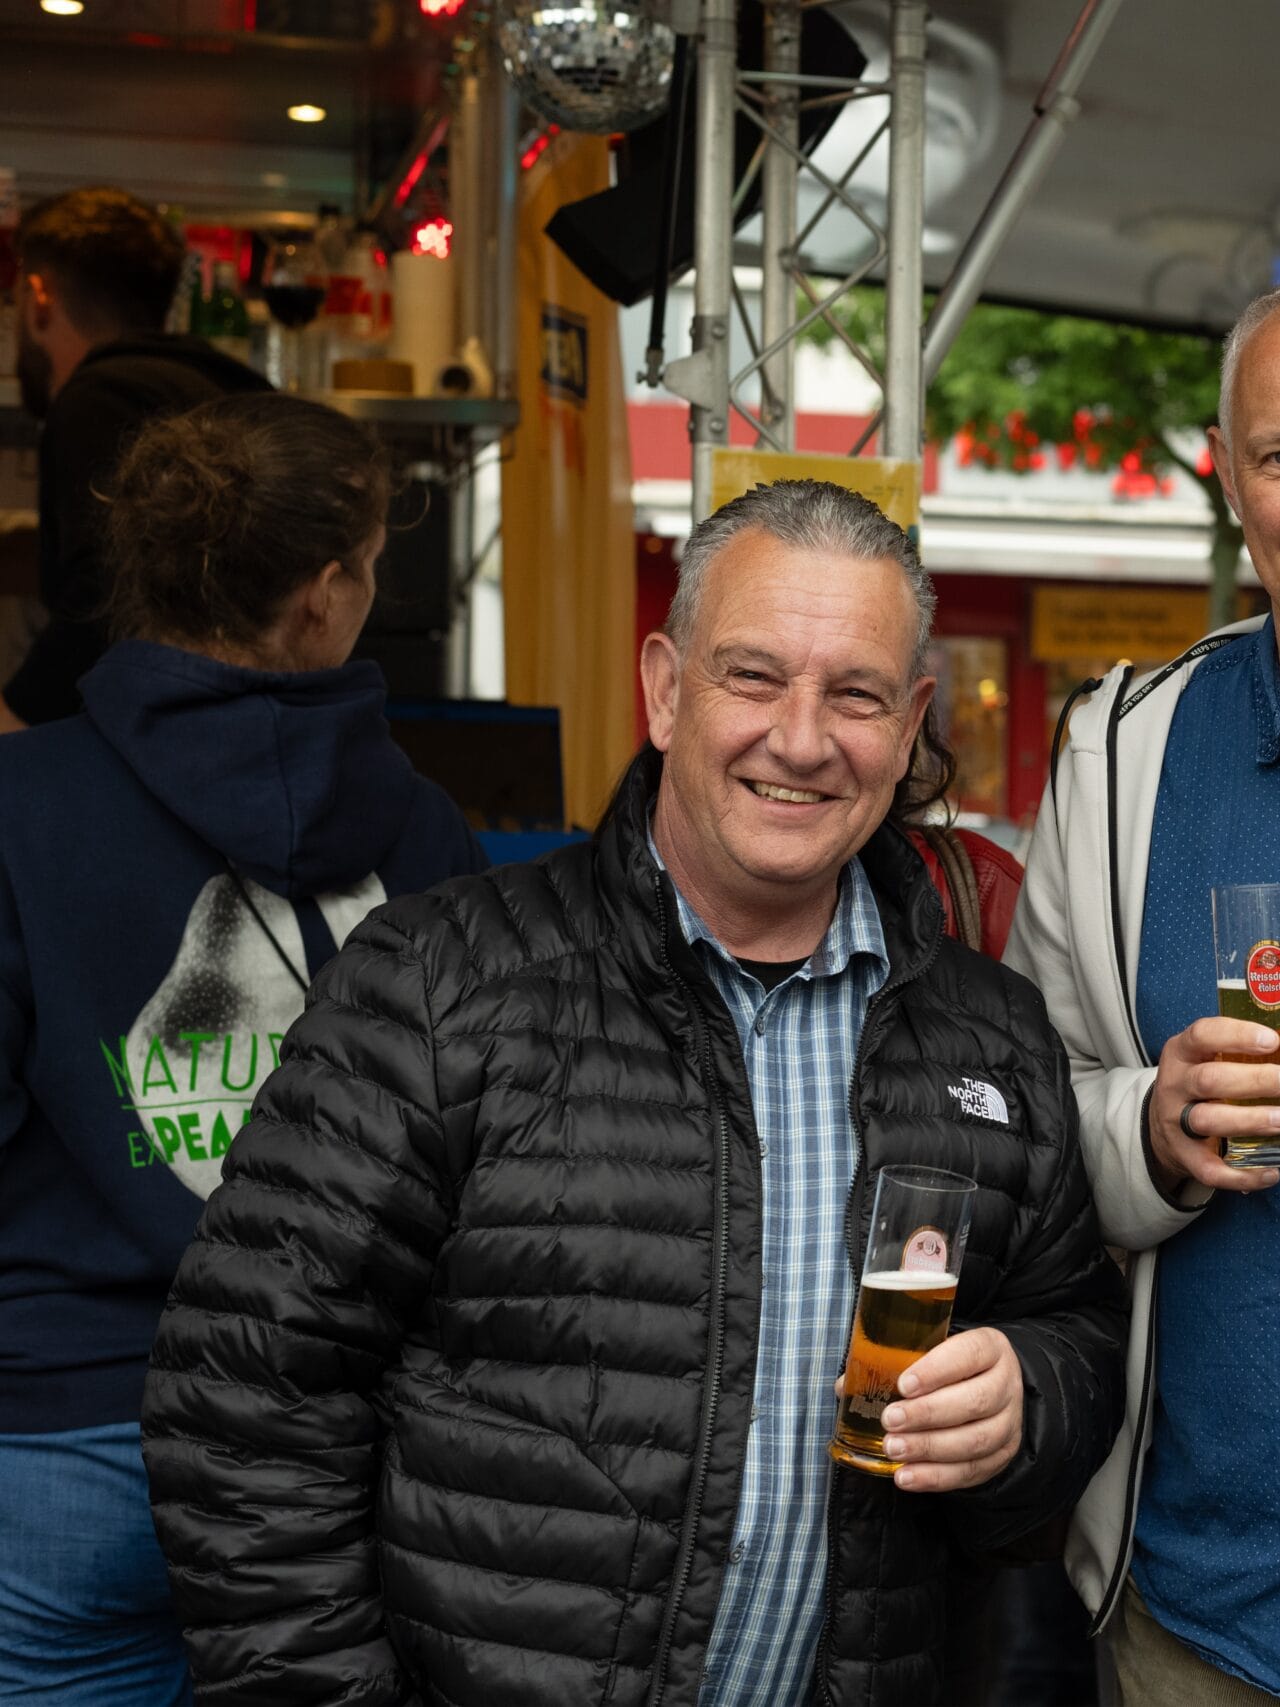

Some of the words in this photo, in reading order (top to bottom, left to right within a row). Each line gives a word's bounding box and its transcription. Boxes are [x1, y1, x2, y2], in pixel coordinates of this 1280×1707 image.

[1118, 701, 1133, 716] EEPS
[1131, 691, 1143, 703] YOU
[1142, 683, 1153, 695] DRY
[947, 1085, 987, 1106] NORTH
[962, 1077, 985, 1094] THE
[961, 1100, 989, 1119] FACE
[128, 1109, 250, 1168] EXPEA
